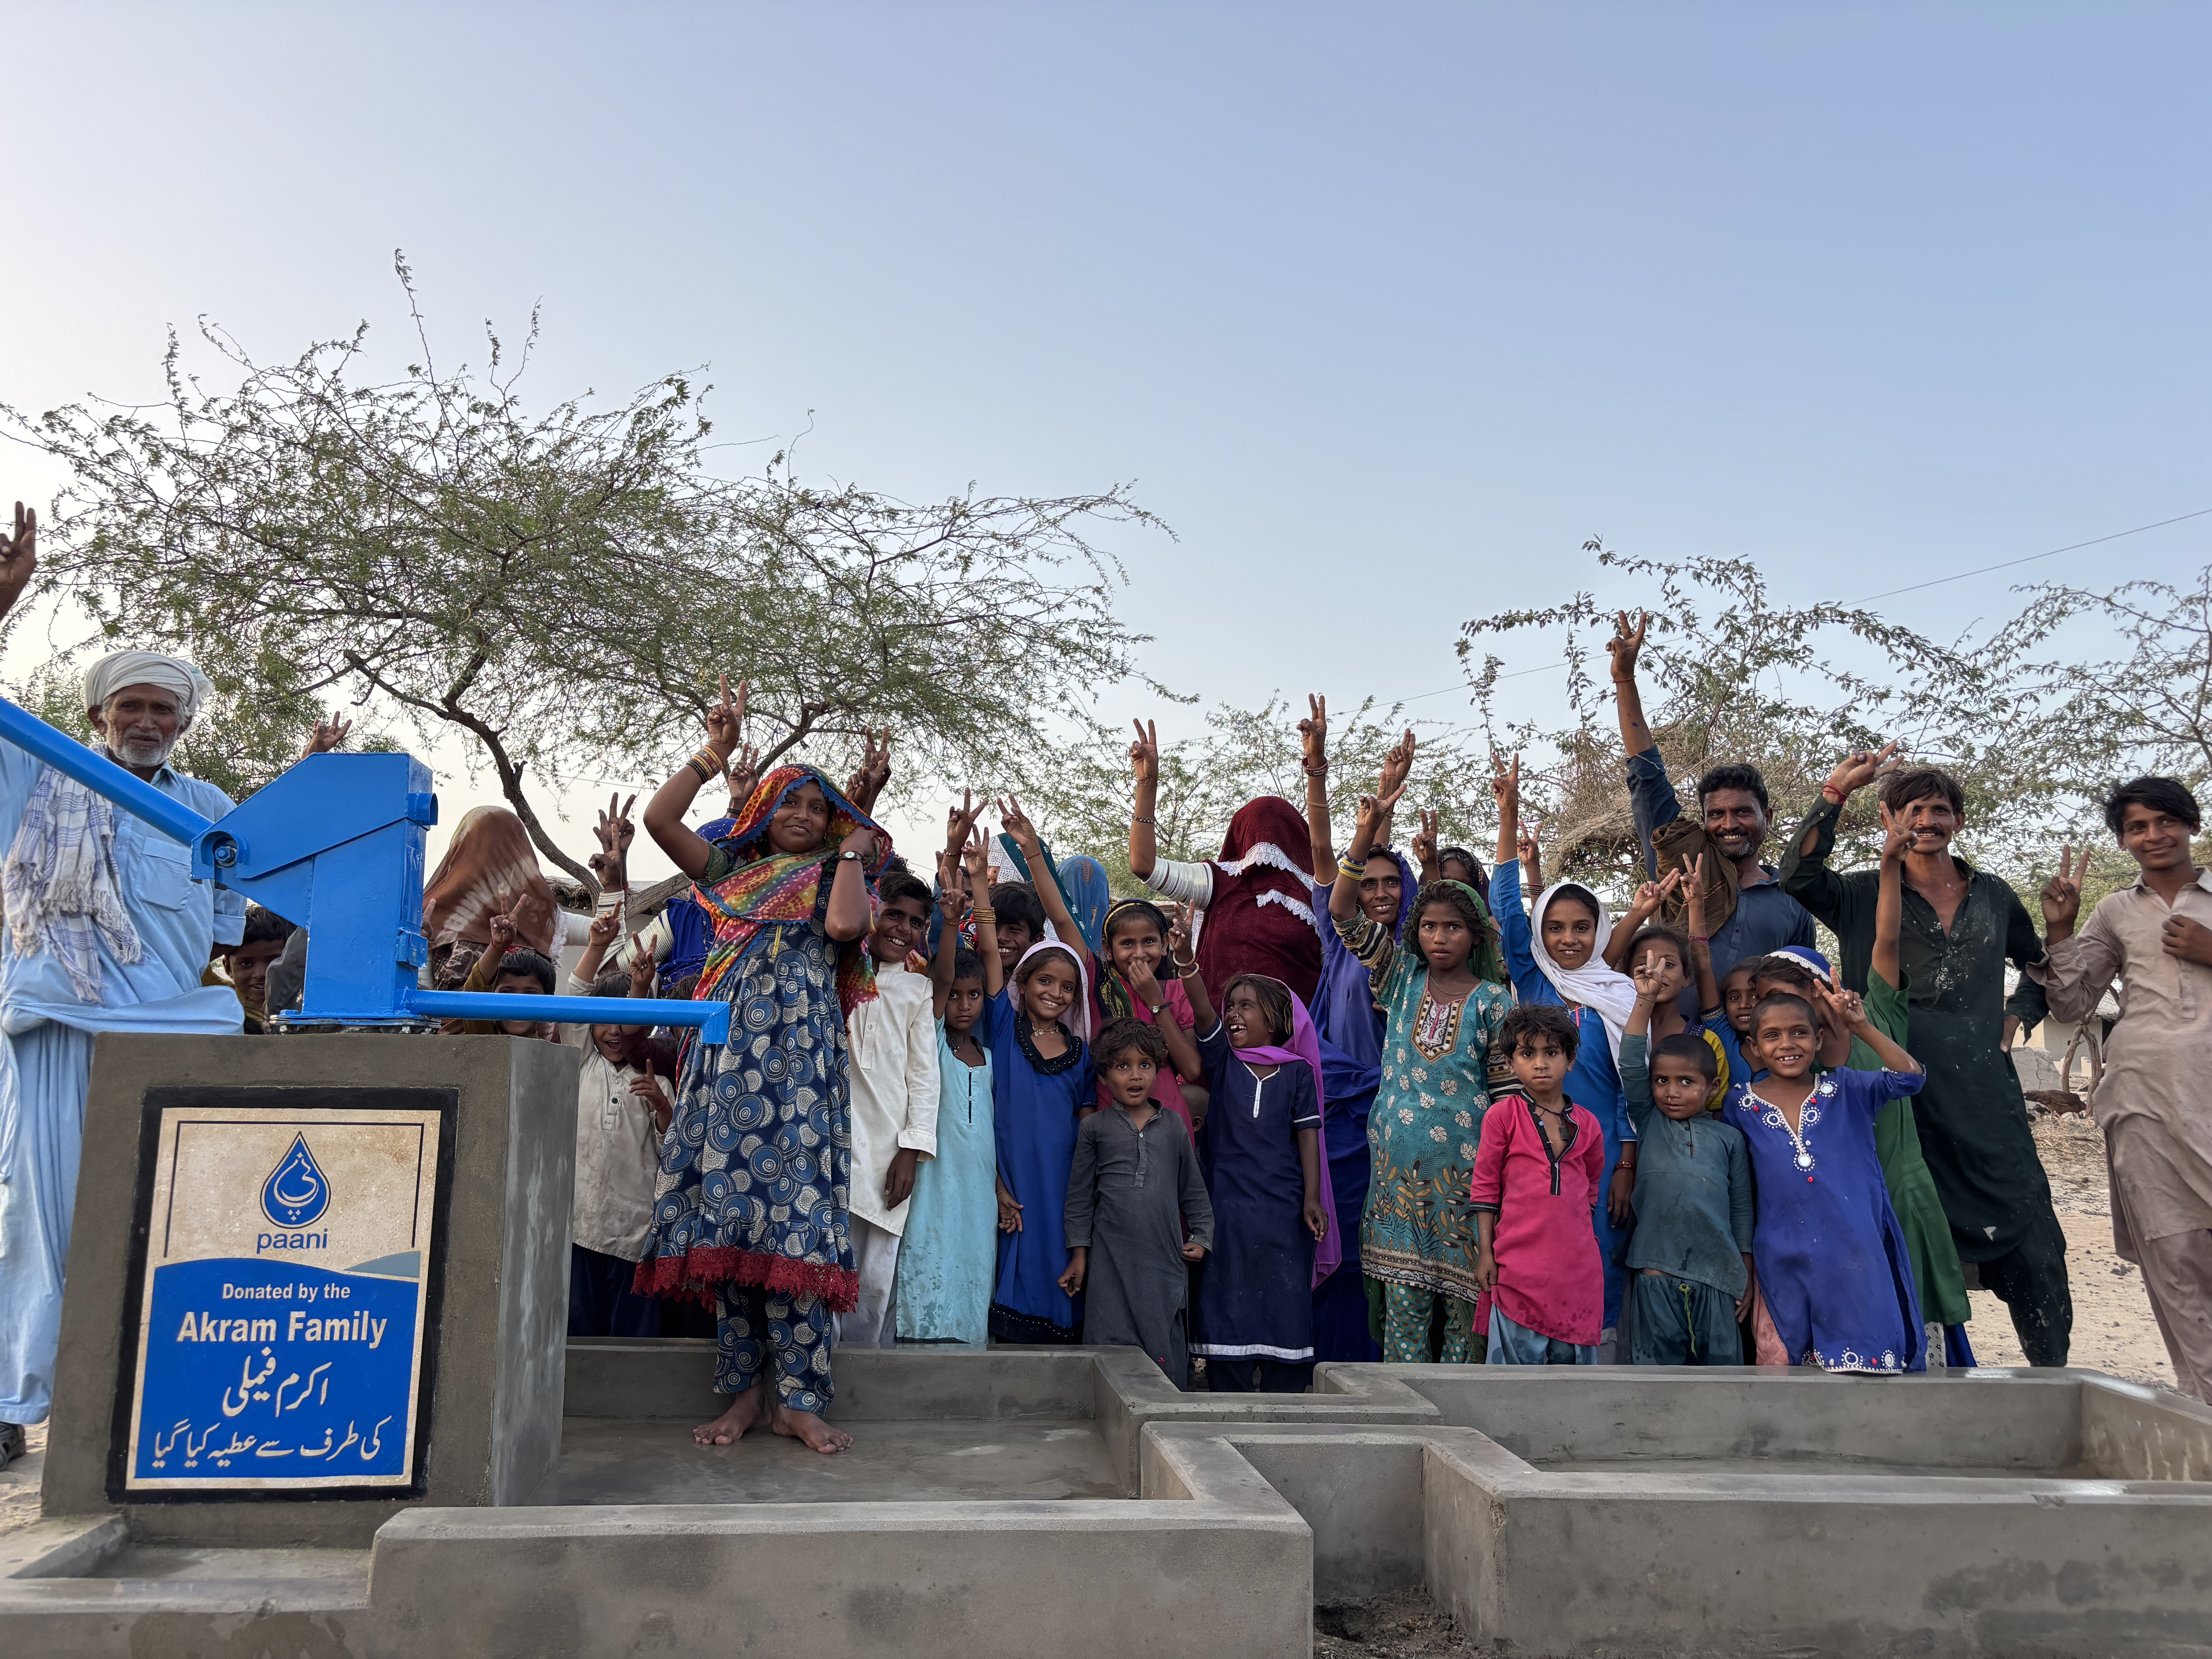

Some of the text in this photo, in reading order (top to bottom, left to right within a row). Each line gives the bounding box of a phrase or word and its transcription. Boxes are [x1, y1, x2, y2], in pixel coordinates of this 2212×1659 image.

[256, 1228, 328, 1255] paani
[222, 1283, 350, 1303] Donated by the
[177, 1310, 388, 1349] Akram Family
[222, 1346, 333, 1418] اکرم فیملی
[152, 1415, 392, 1468] کی طرف سے عطیہ کیا گیا
